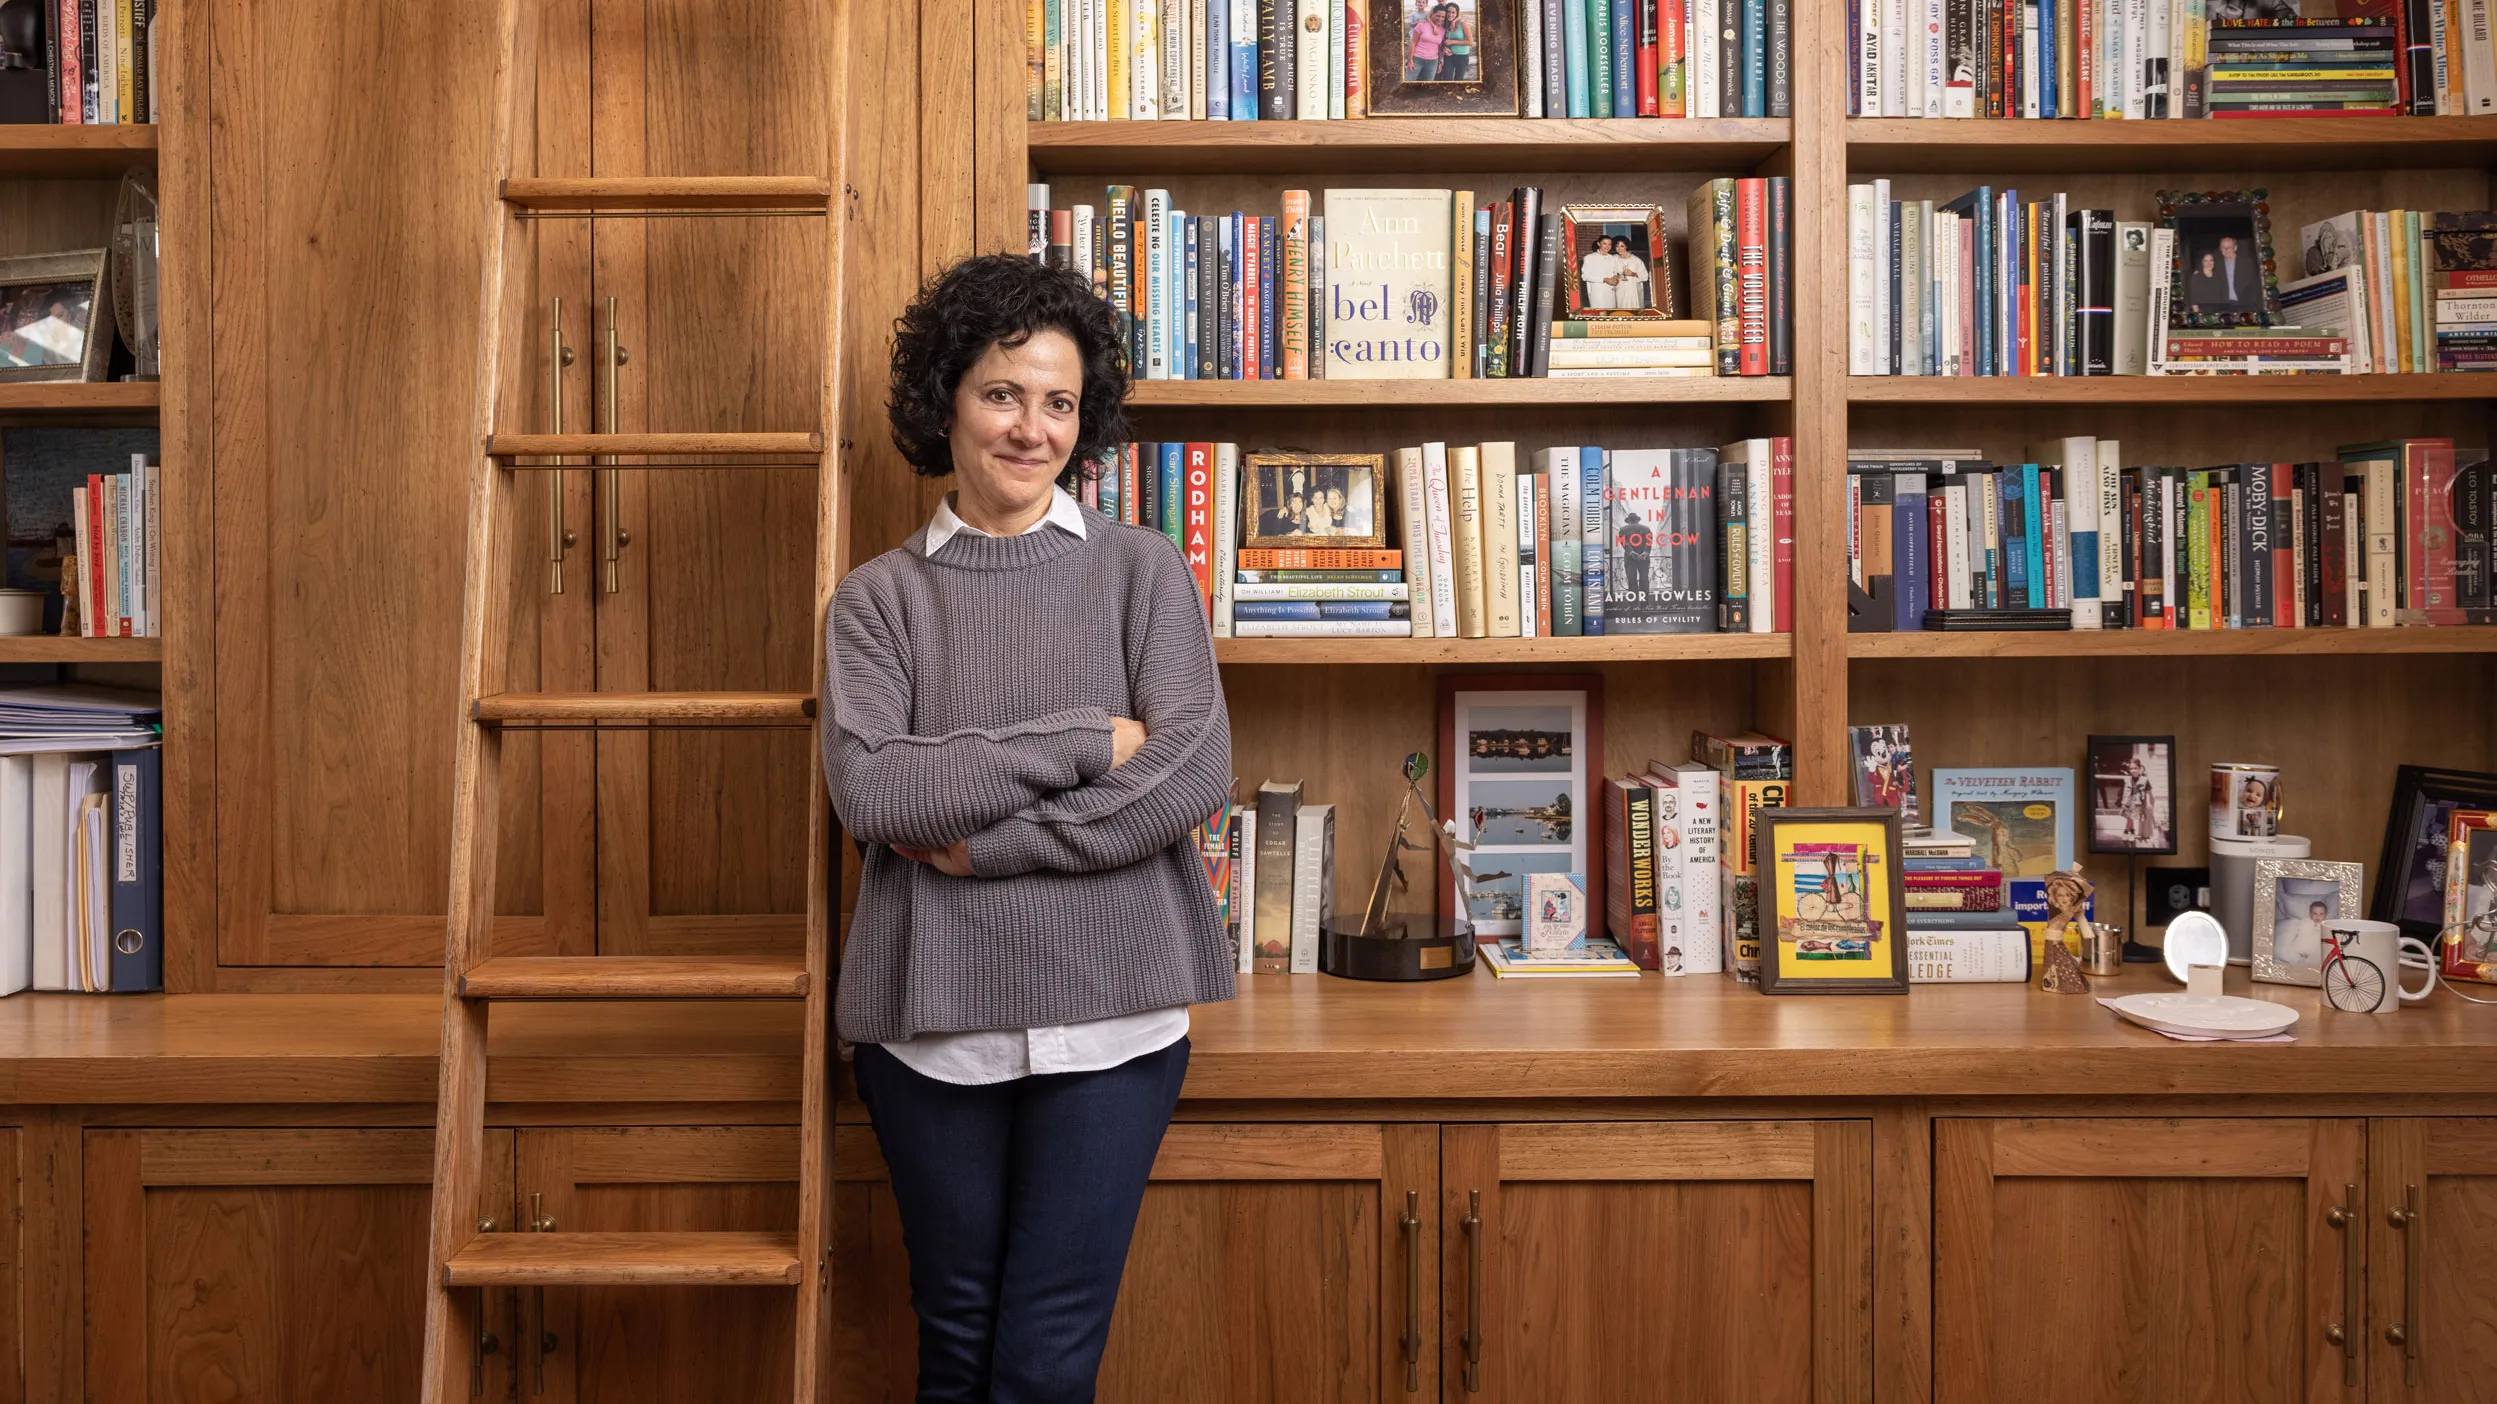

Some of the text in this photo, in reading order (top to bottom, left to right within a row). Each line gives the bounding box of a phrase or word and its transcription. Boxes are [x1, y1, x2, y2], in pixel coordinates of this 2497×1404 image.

[1280, 22, 1285, 31] IS
[1549, 3, 1557, 48] EVENING
[2473, 14, 2486, 41] DILLARD
[1599, 0, 1608, 94] PARIS BOOKSELLER
[1669, 17, 1677, 87] James McBride
[1776, 4, 1785, 85] OF THE WOODS
[1309, 37, 1317, 99] PACHINKO
[1867, 33, 1877, 96] AYAD AKHTAR
[1112, 199, 1126, 239] HELLO
[1152, 198, 1160, 232] CELESTE
[1360, 205, 1419, 234] Ann
[1152, 236, 1159, 249] NG
[1247, 224, 1256, 249] MAGGIE
[1152, 253, 1160, 272] OUR
[1247, 253, 1256, 289] O'FARRELL
[1332, 241, 1446, 270] Patchett
[1493, 224, 1508, 332] Bear Julia Phillips
[1152, 277, 1160, 315] MISSING
[1332, 283, 1392, 321] bel
[1743, 244, 1763, 344] THE VOLUNTEER
[2446, 302, 2496, 310] Thornton
[1286, 292, 1305, 354] HIMSELF
[2455, 312, 2490, 320] Wilder
[1330, 337, 1440, 365] canto
[1651, 466, 1660, 477] A
[119, 486, 127, 513] MICHAEL
[1167, 452, 1179, 529] Gary Shteyngart
[1460, 467, 1477, 522] The Help
[1603, 486, 1710, 500] GENTLEMAN
[148, 479, 156, 567] Stephen King On Writing
[1190, 450, 1206, 565] RODHAM
[1648, 509, 1665, 522] IN
[2143, 479, 2155, 544] Mockingbird
[2252, 467, 2267, 552] MOBY-DICK
[2469, 491, 2477, 525] TOLSTOY
[1586, 468, 1602, 612] COLM TÓIBÍN LONG ISLAND
[1615, 533, 1699, 548] MOSCOW
[1732, 528, 1741, 552] RULES
[2104, 533, 2112, 585] HEMINGWAY
[1732, 560, 1741, 591] CIVILITY
[1288, 586, 1344, 598] Elizabeth
[1347, 587, 1384, 598] Strout
[1605, 590, 1711, 603] AMOR TOWLES
[1959, 777, 2062, 787] VELVETEEN RABBIT
[1244, 817, 1252, 844] Another
[1243, 847, 1251, 877] Brooklyn
[1631, 800, 1652, 908] WONDERWORKS
[1690, 855, 1715, 863] AMERICA
[1304, 832, 1320, 942] A LITTLE LIFE
[1910, 951, 1952, 961] ESSENTIAL
[1927, 936, 1954, 946] Times
[1910, 964, 1952, 978] LEDGE
